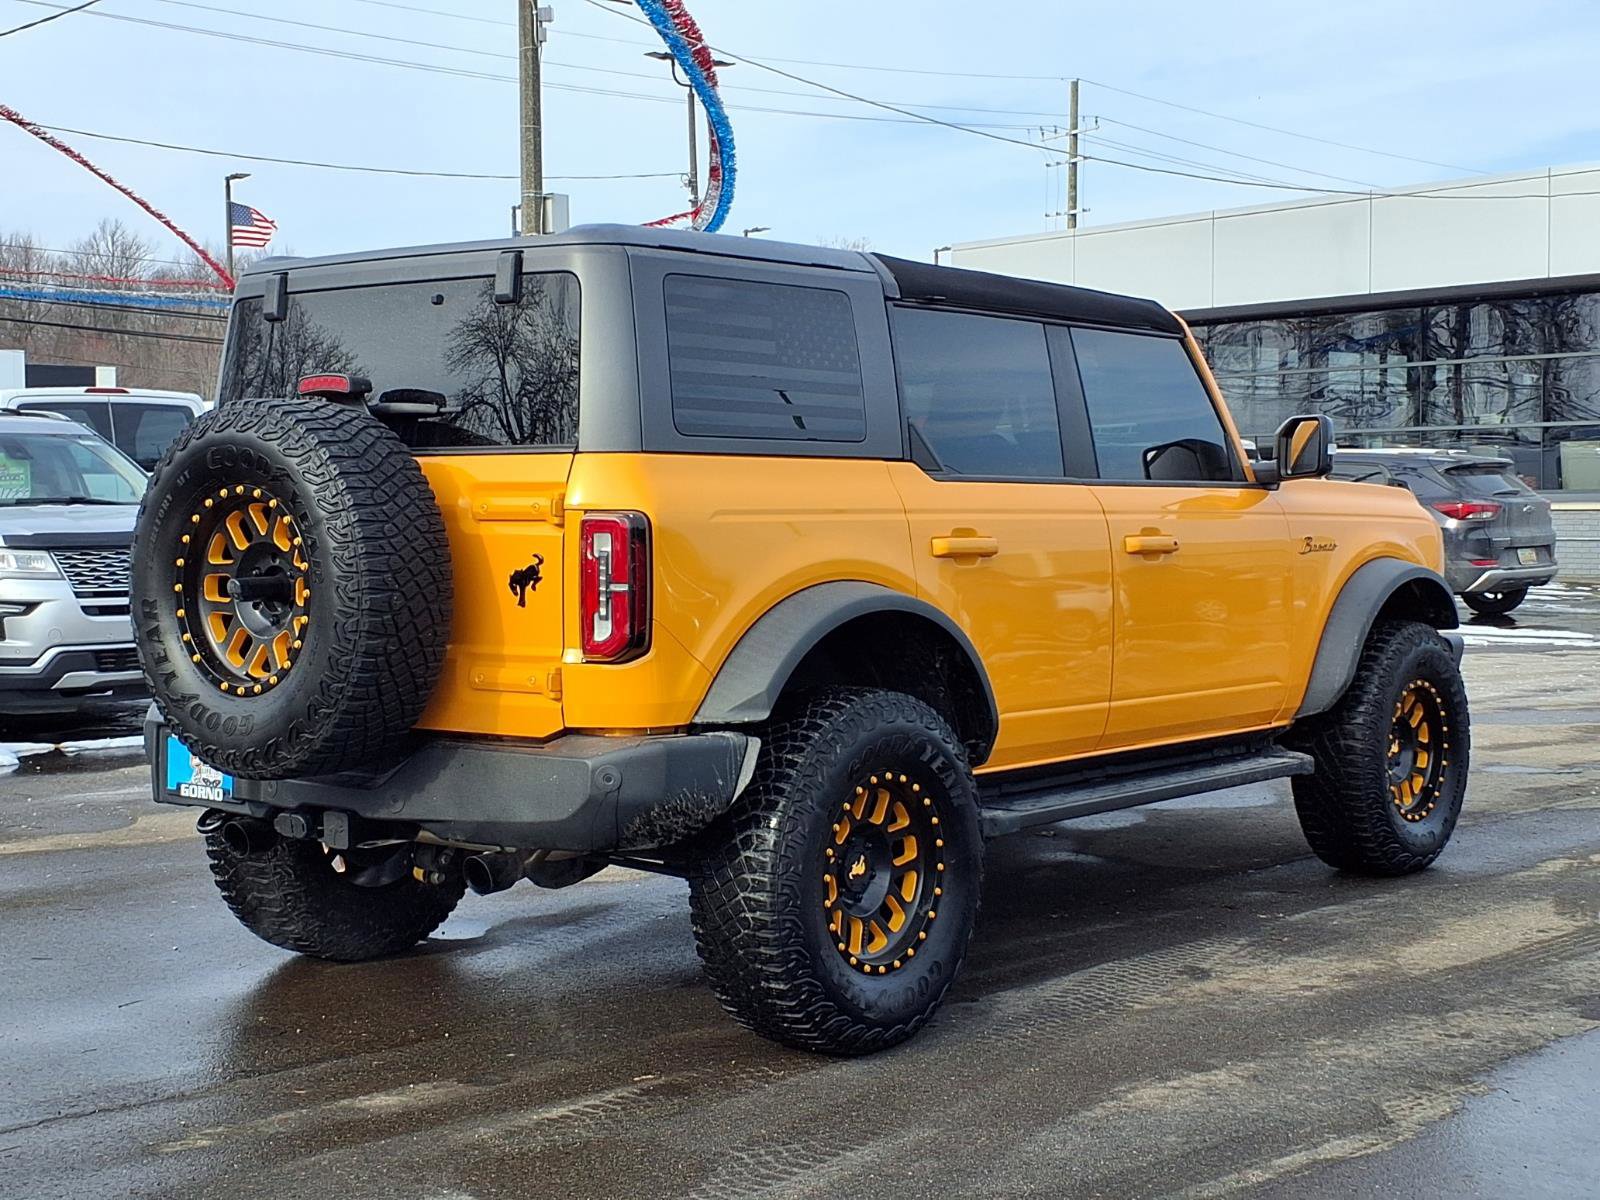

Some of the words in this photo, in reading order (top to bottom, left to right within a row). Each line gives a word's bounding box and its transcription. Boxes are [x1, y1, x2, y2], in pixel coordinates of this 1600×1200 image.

[1298, 536, 1338, 555] Bronco
[141, 598, 255, 737] GOODYEAR
[181, 784, 224, 802] GORNO
